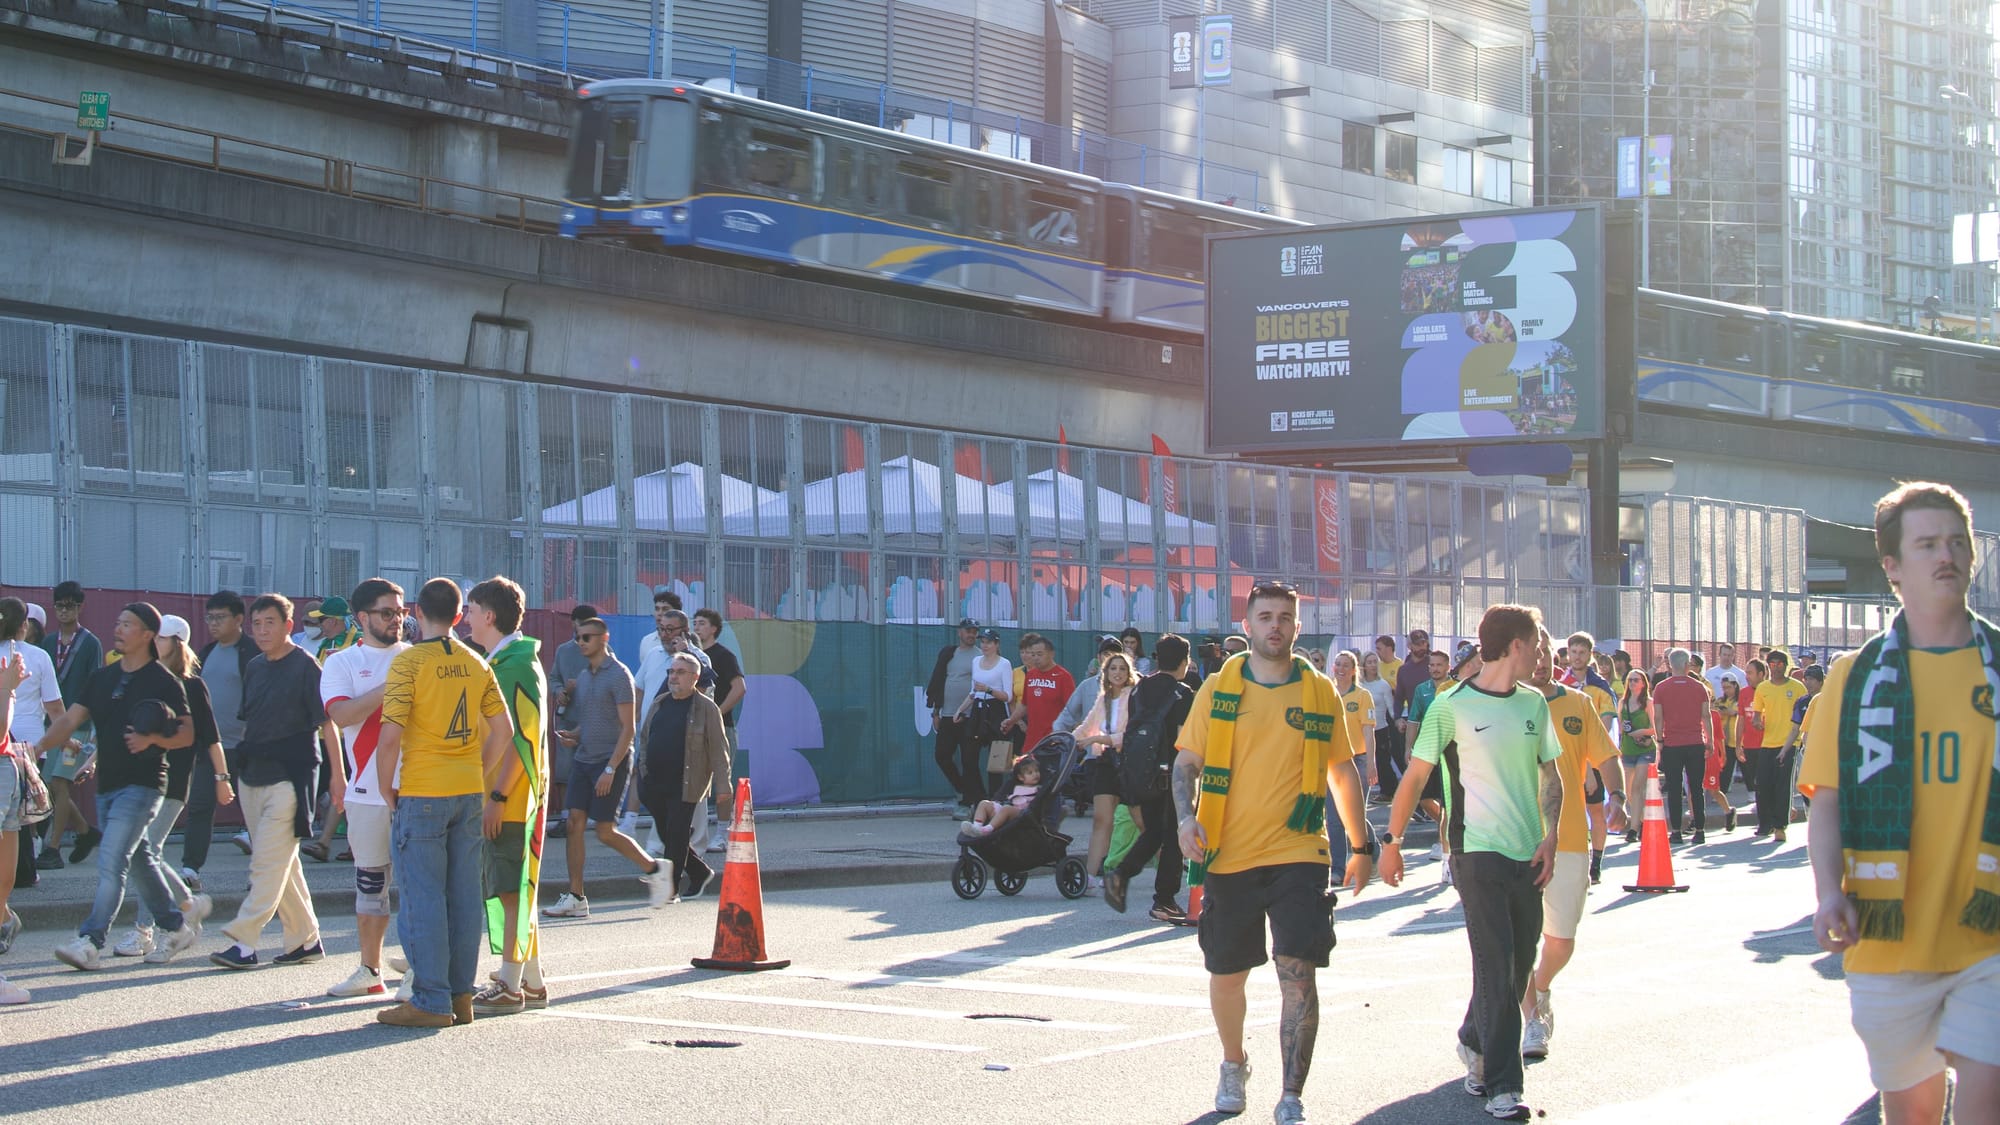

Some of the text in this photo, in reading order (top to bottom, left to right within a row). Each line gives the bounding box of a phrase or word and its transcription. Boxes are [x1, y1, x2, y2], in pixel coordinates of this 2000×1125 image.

[81, 93, 108, 105] CLEAR OF
[88, 105, 97, 116] ALL
[79, 117, 105, 128] SWITCHES
[1304, 245, 1323, 255] FAN
[1301, 255, 1323, 266] FEST
[1463, 281, 1477, 290] LIVE
[1463, 289, 1485, 298] MATCH
[1256, 300, 1350, 312] VANCOUVER'S
[1463, 296, 1494, 306] VIEWINGS
[1255, 310, 1350, 341] BIGGEST
[1521, 319, 1544, 327] FAMILY
[1413, 325, 1446, 334] LOCAL EATS
[1521, 327, 1534, 336] FUN
[1256, 340, 1350, 361] FREE
[1256, 360, 1350, 380] WATCH PARTY!
[1464, 389, 1477, 397] LIVE
[1464, 395, 1512, 405] ENTERTAINMENT
[436, 664, 471, 680] CAHILL
[444, 686, 472, 746] 4
[1920, 731, 1960, 784] 10
[1709, 776, 1716, 785] 9
